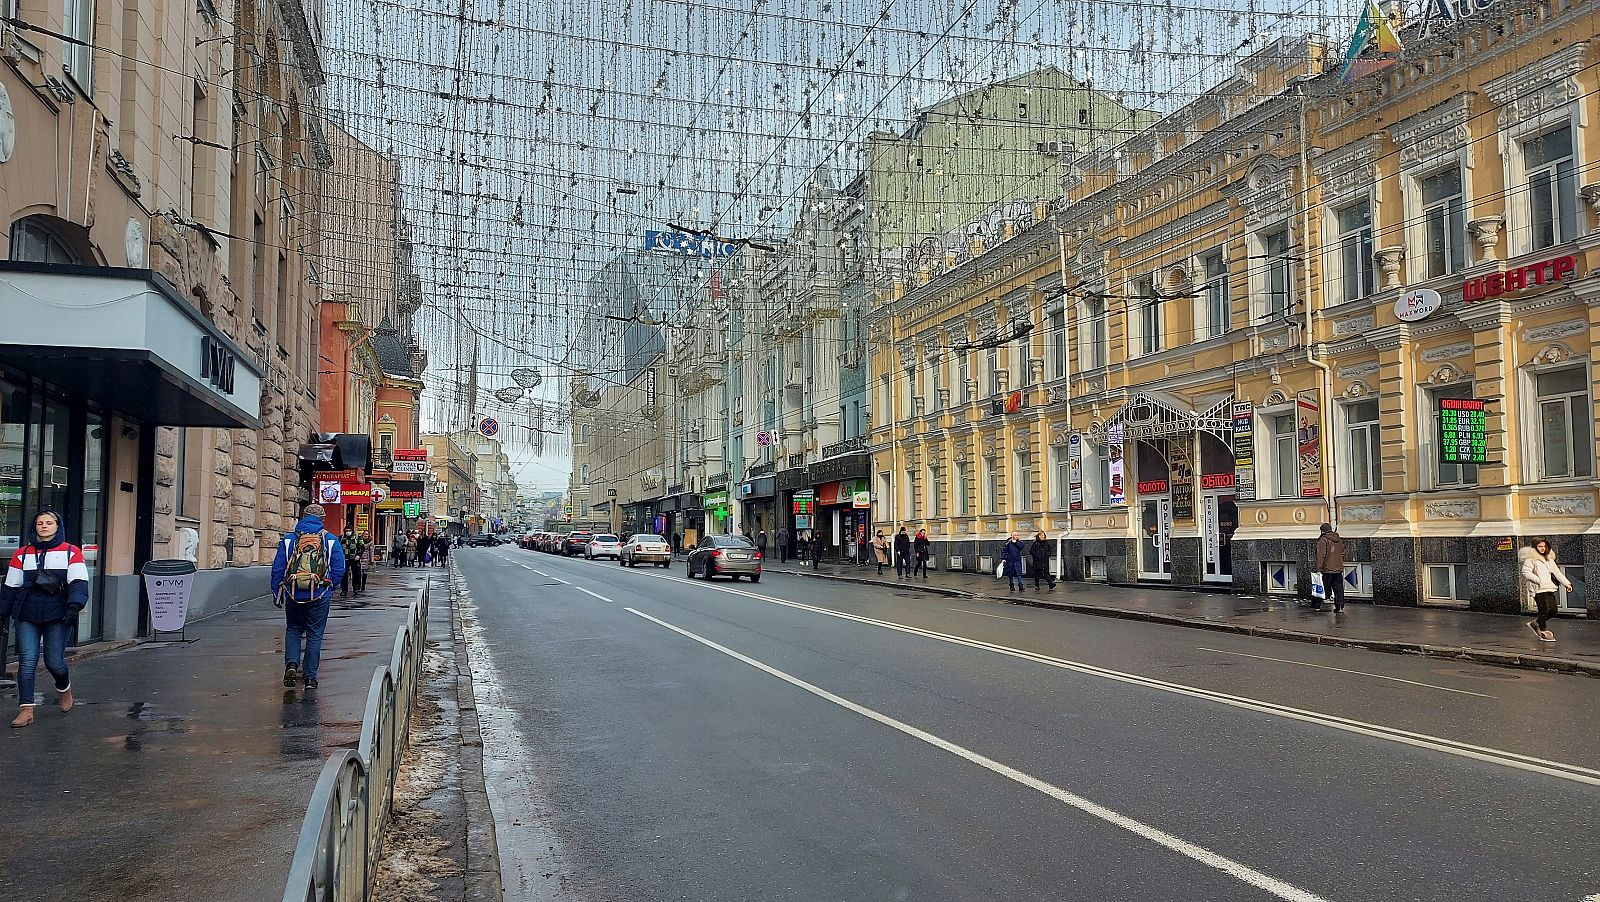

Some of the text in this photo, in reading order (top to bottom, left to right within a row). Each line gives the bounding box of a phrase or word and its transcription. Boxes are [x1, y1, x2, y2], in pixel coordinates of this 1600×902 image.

[1462, 255, 1576, 303] ЦЕНТР
[1399, 305, 1433, 319] MAXWORD
[1235, 425, 1251, 433] КАССА
[1139, 481, 1166, 492] ЗОЛОТО
[390, 490, 422, 498] ЛОМБАРД
